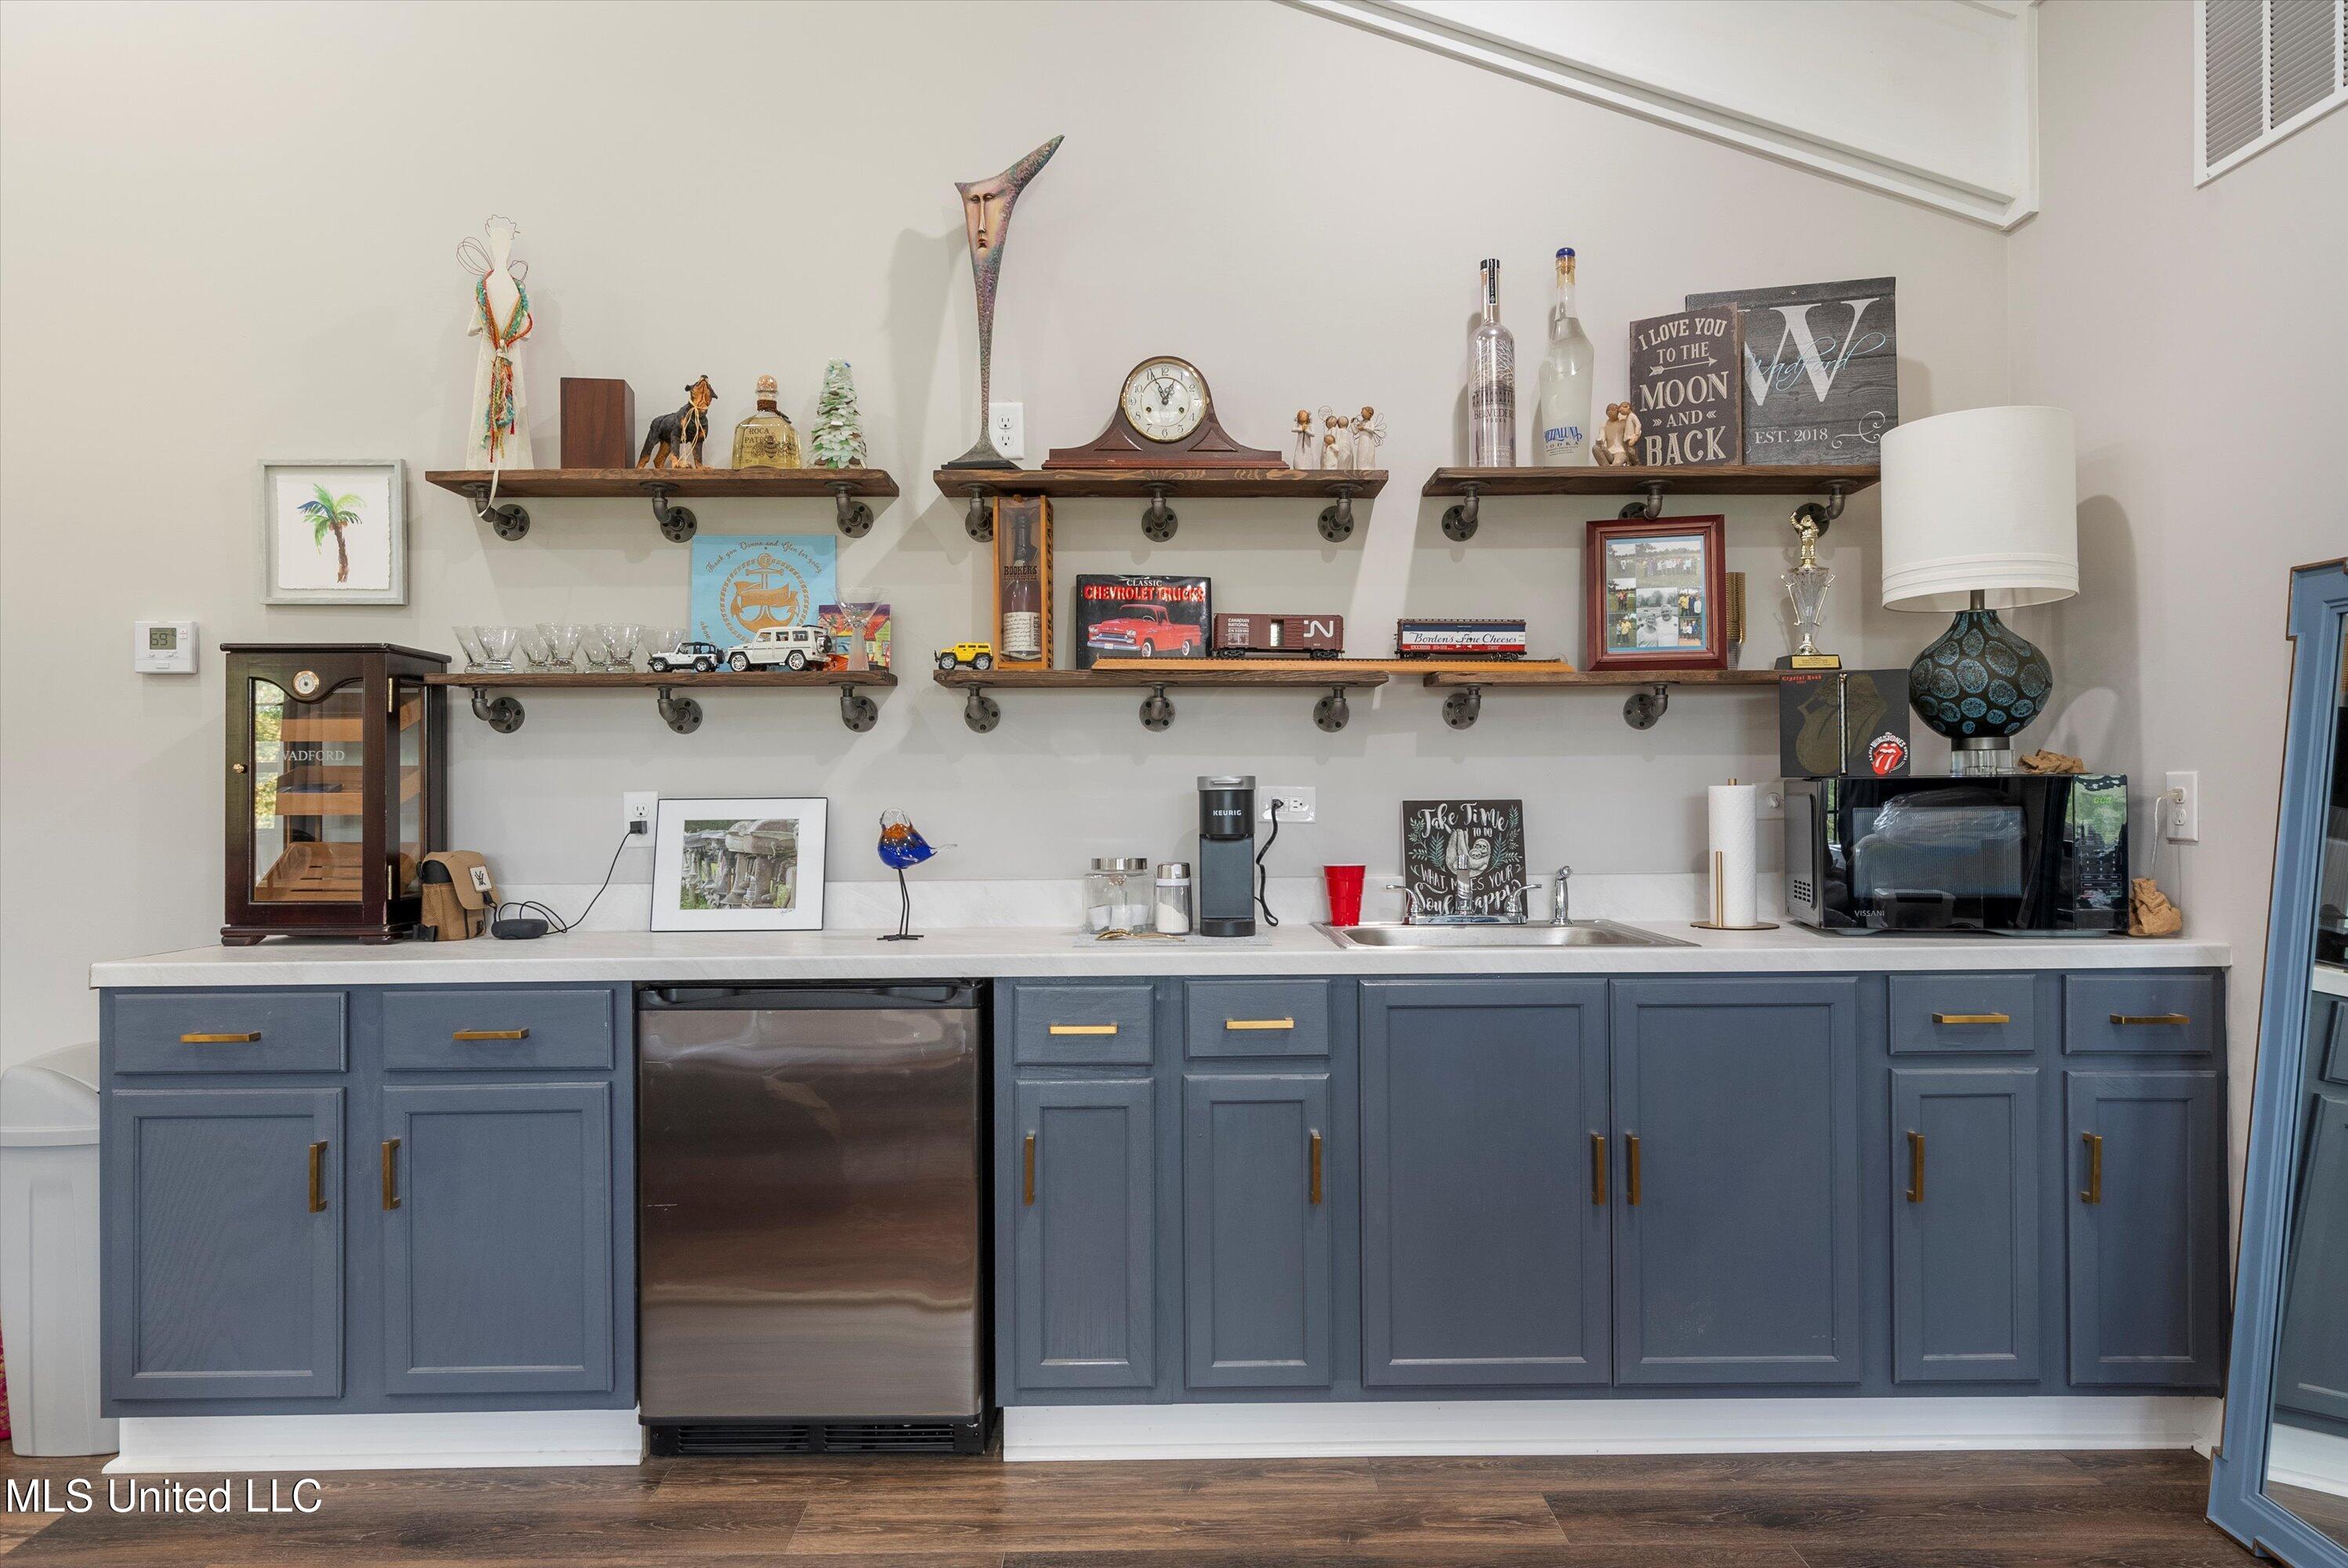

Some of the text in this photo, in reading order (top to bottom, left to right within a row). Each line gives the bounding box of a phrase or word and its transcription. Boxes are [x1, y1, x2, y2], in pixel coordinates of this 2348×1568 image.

[1639, 318, 1727, 350] I LOVE YOU
[1657, 342, 1709, 365] TO THE
[1737, 298, 1879, 406] W
[1162, 367, 1170, 376] 12
[1639, 371, 1729, 412] MOON
[1135, 412, 1141, 420] 8
[1666, 410, 1703, 428] AND
[1162, 429, 1167, 437] 6
[1755, 428, 1828, 445] EST. 2018
[1645, 426, 1726, 466] BACK
[706, 555, 724, 573] Thank
[1083, 583, 1205, 602] CHEVROLET TRUCKS
[1410, 632, 1453, 643] Borden's
[1482, 633, 1517, 643] Cheeses
[1417, 803, 1458, 838] Take
[1472, 828, 1493, 837] TO DO
[1421, 864, 1513, 891] WHAT MES YOUR
